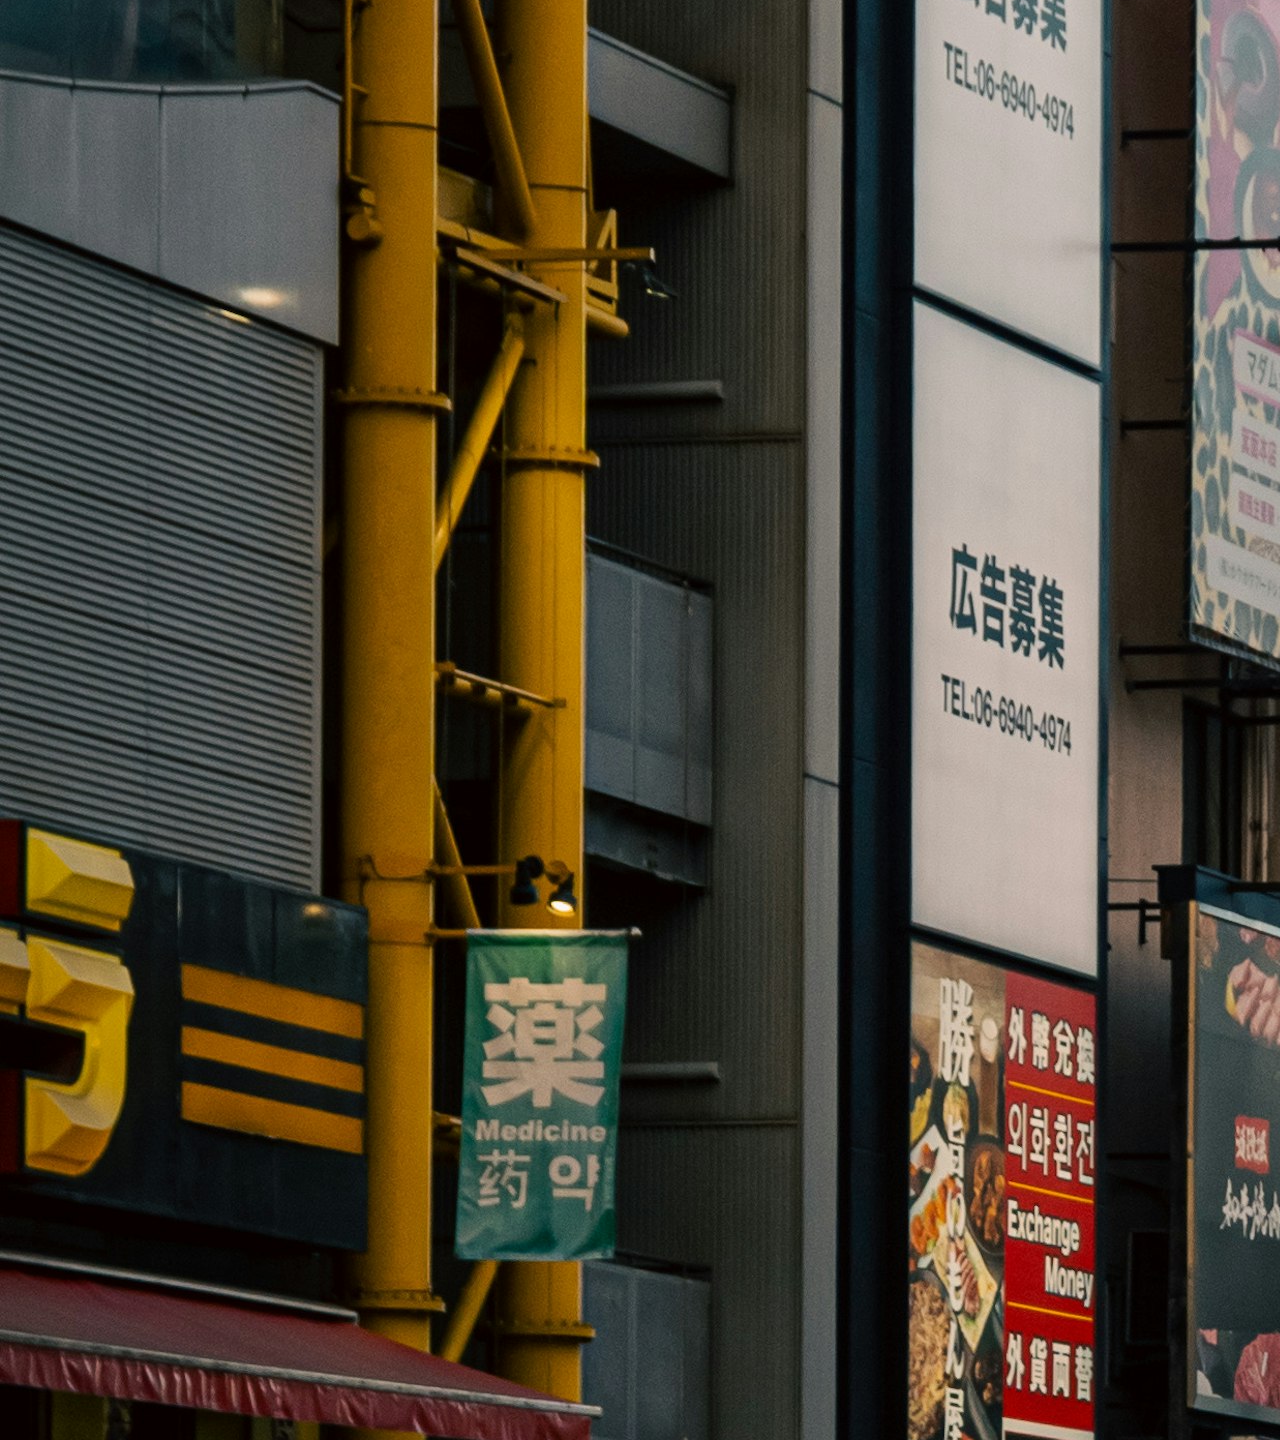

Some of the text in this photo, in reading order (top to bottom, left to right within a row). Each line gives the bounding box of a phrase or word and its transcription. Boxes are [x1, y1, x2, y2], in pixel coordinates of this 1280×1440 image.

[944, 41, 1075, 141] TEL:06-6940-4974
[949, 543, 1064, 670] 広告募集
[941, 674, 1072, 757] TEL:06-6940-4974
[481, 977, 607, 1108] 薬
[475, 1118, 607, 1143] Medicine
[1008, 1101, 1095, 1186] 외화환전
[476, 1149, 602, 1213] 药 약
[1006, 1198, 1081, 1257] Exchange
[1044, 1254, 1094, 1309] Money
[1001, 1332, 1093, 1403] 外貨両替
